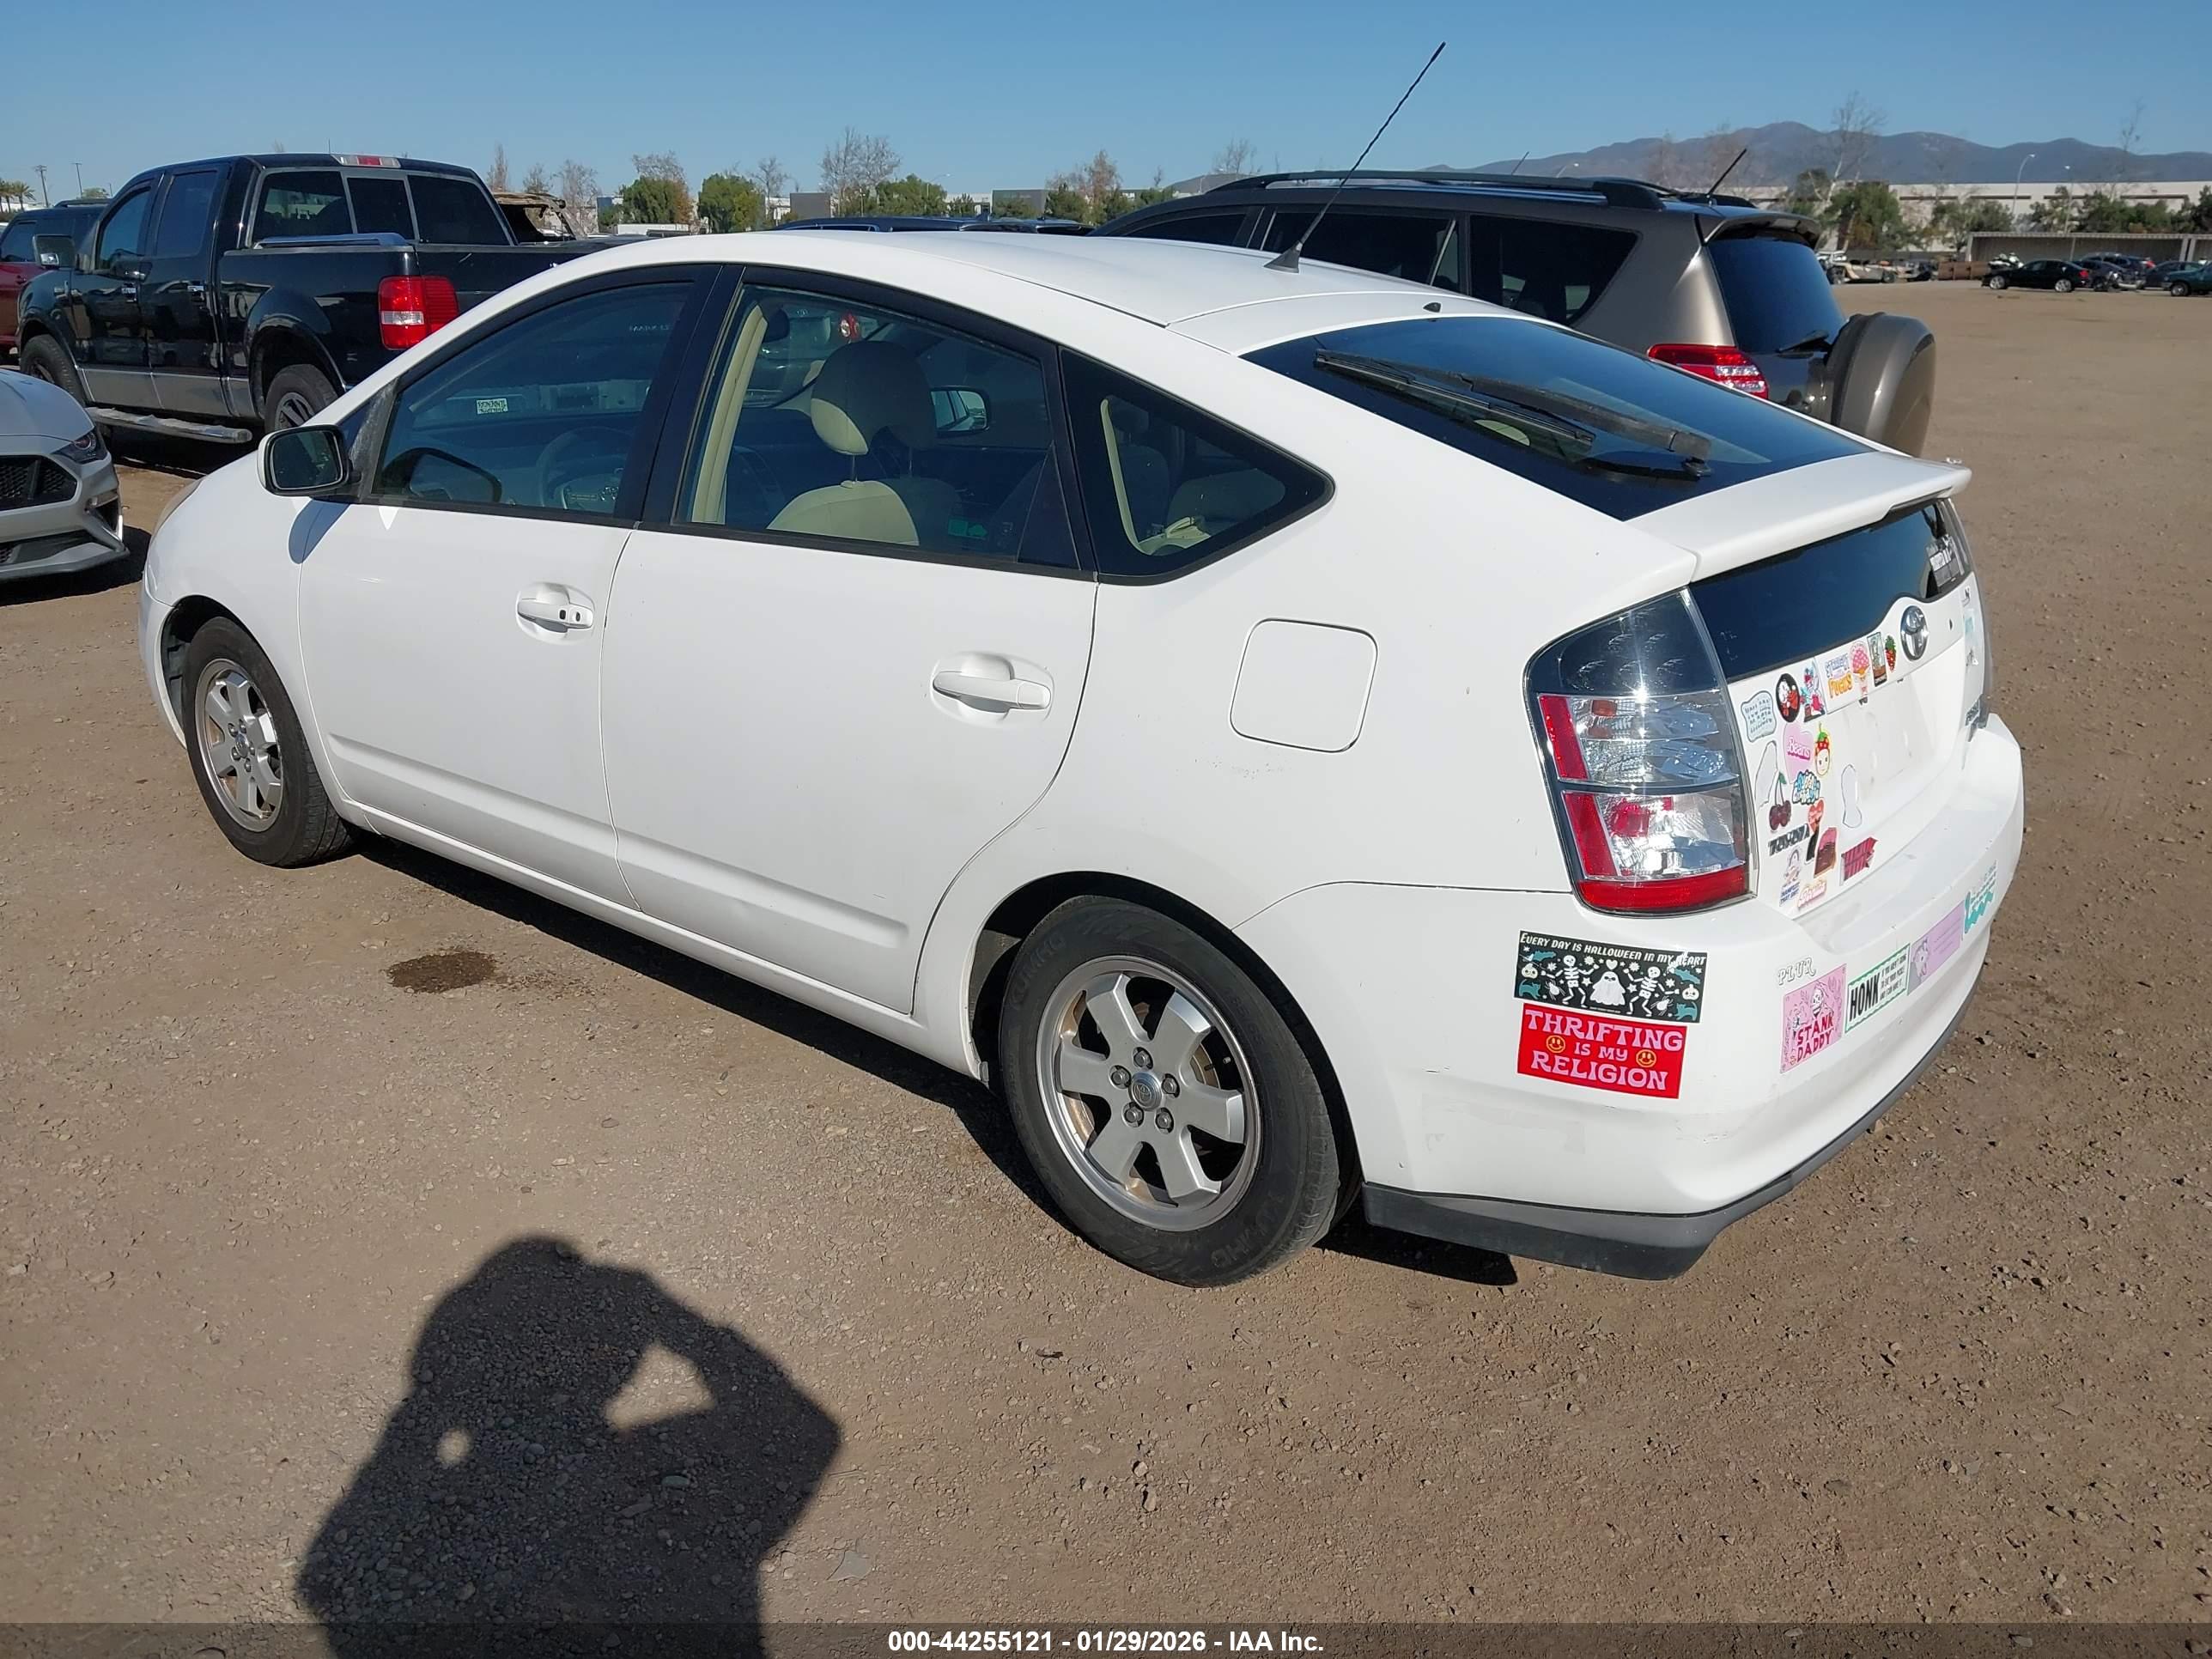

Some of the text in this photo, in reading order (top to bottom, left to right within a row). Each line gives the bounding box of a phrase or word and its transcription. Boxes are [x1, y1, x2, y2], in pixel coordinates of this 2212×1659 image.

[1788, 737, 1811, 760] Beans
[1551, 939, 1572, 950] DAY
[1571, 943, 1583, 952] IS
[1583, 945, 1643, 961] HALLOWEEN
[1644, 952, 1656, 962] IN
[1656, 954, 1674, 965] MY
[1778, 957, 1816, 986] PLUR
[1849, 972, 1881, 1022] HONK
[1525, 1010, 1683, 1051] THRIFTING
[1796, 1012, 1834, 1047] STANK
[1574, 1042, 1628, 1061] IS MY
[1796, 1030, 1832, 1063] DADDY
[1530, 1049, 1668, 1091] RELIGION
